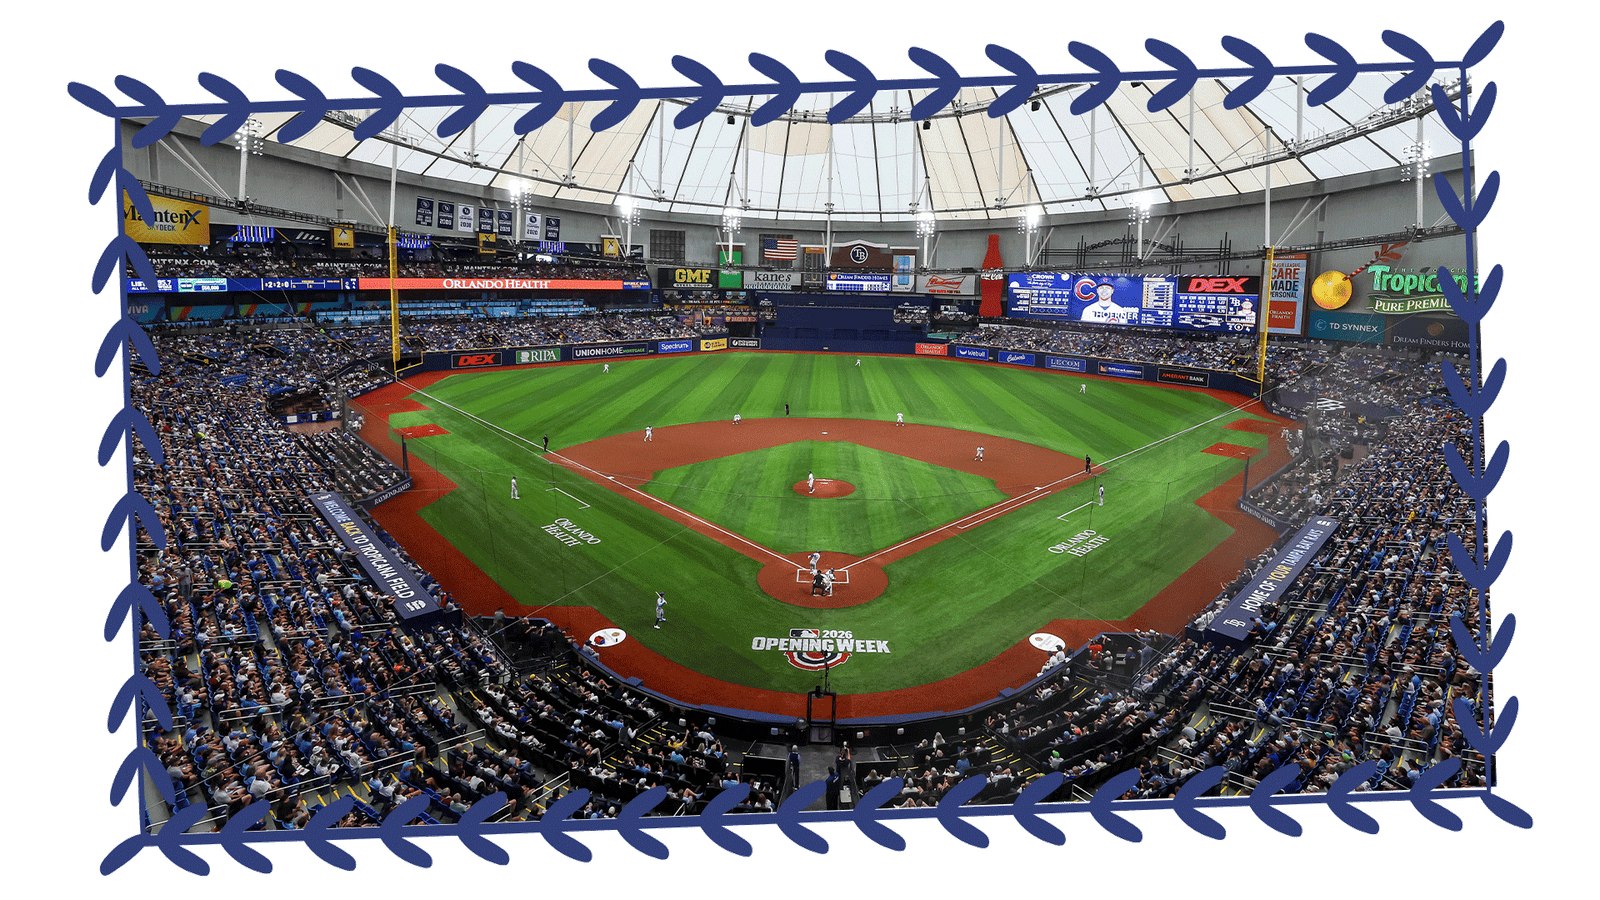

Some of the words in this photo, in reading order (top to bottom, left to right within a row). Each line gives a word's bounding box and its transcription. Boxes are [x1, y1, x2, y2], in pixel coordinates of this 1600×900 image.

[854, 249, 865, 260] TB
[675, 269, 711, 283] GMF
[1271, 268, 1300, 280] CARE
[443, 279, 503, 289] ORLANDO
[505, 279, 548, 288] HEALTH
[1188, 278, 1249, 292] DEX
[1375, 300, 1404, 311] PURE
[1342, 324, 1378, 332] SYNNEX
[661, 343, 686, 351] Spectrum
[1421, 338, 1449, 347] FINDERS
[531, 351, 557, 361] RIPA
[576, 347, 623, 356] UNIONHOME
[458, 354, 495, 366] DEX
[1051, 359, 1080, 367] LECOM
[323, 500, 351, 522] WELCOME
[340, 522, 363, 537] BACK
[541, 524, 583, 547] HEALTH
[555, 518, 601, 544] ORLANDO
[352, 535, 369, 544] TO
[1048, 530, 1096, 553] ORLANDO
[1067, 535, 1110, 556] HEALTH
[359, 543, 398, 579] TROPICANA
[1267, 564, 1292, 582] YOUR
[386, 577, 415, 599] FIELD
[1259, 580, 1277, 591] OF
[1240, 590, 1271, 612] HOME
[1223, 619, 1246, 627] TB
[822, 630, 852, 638] 2026
[751, 637, 834, 651] OPENING
[837, 638, 891, 653] WEEK
